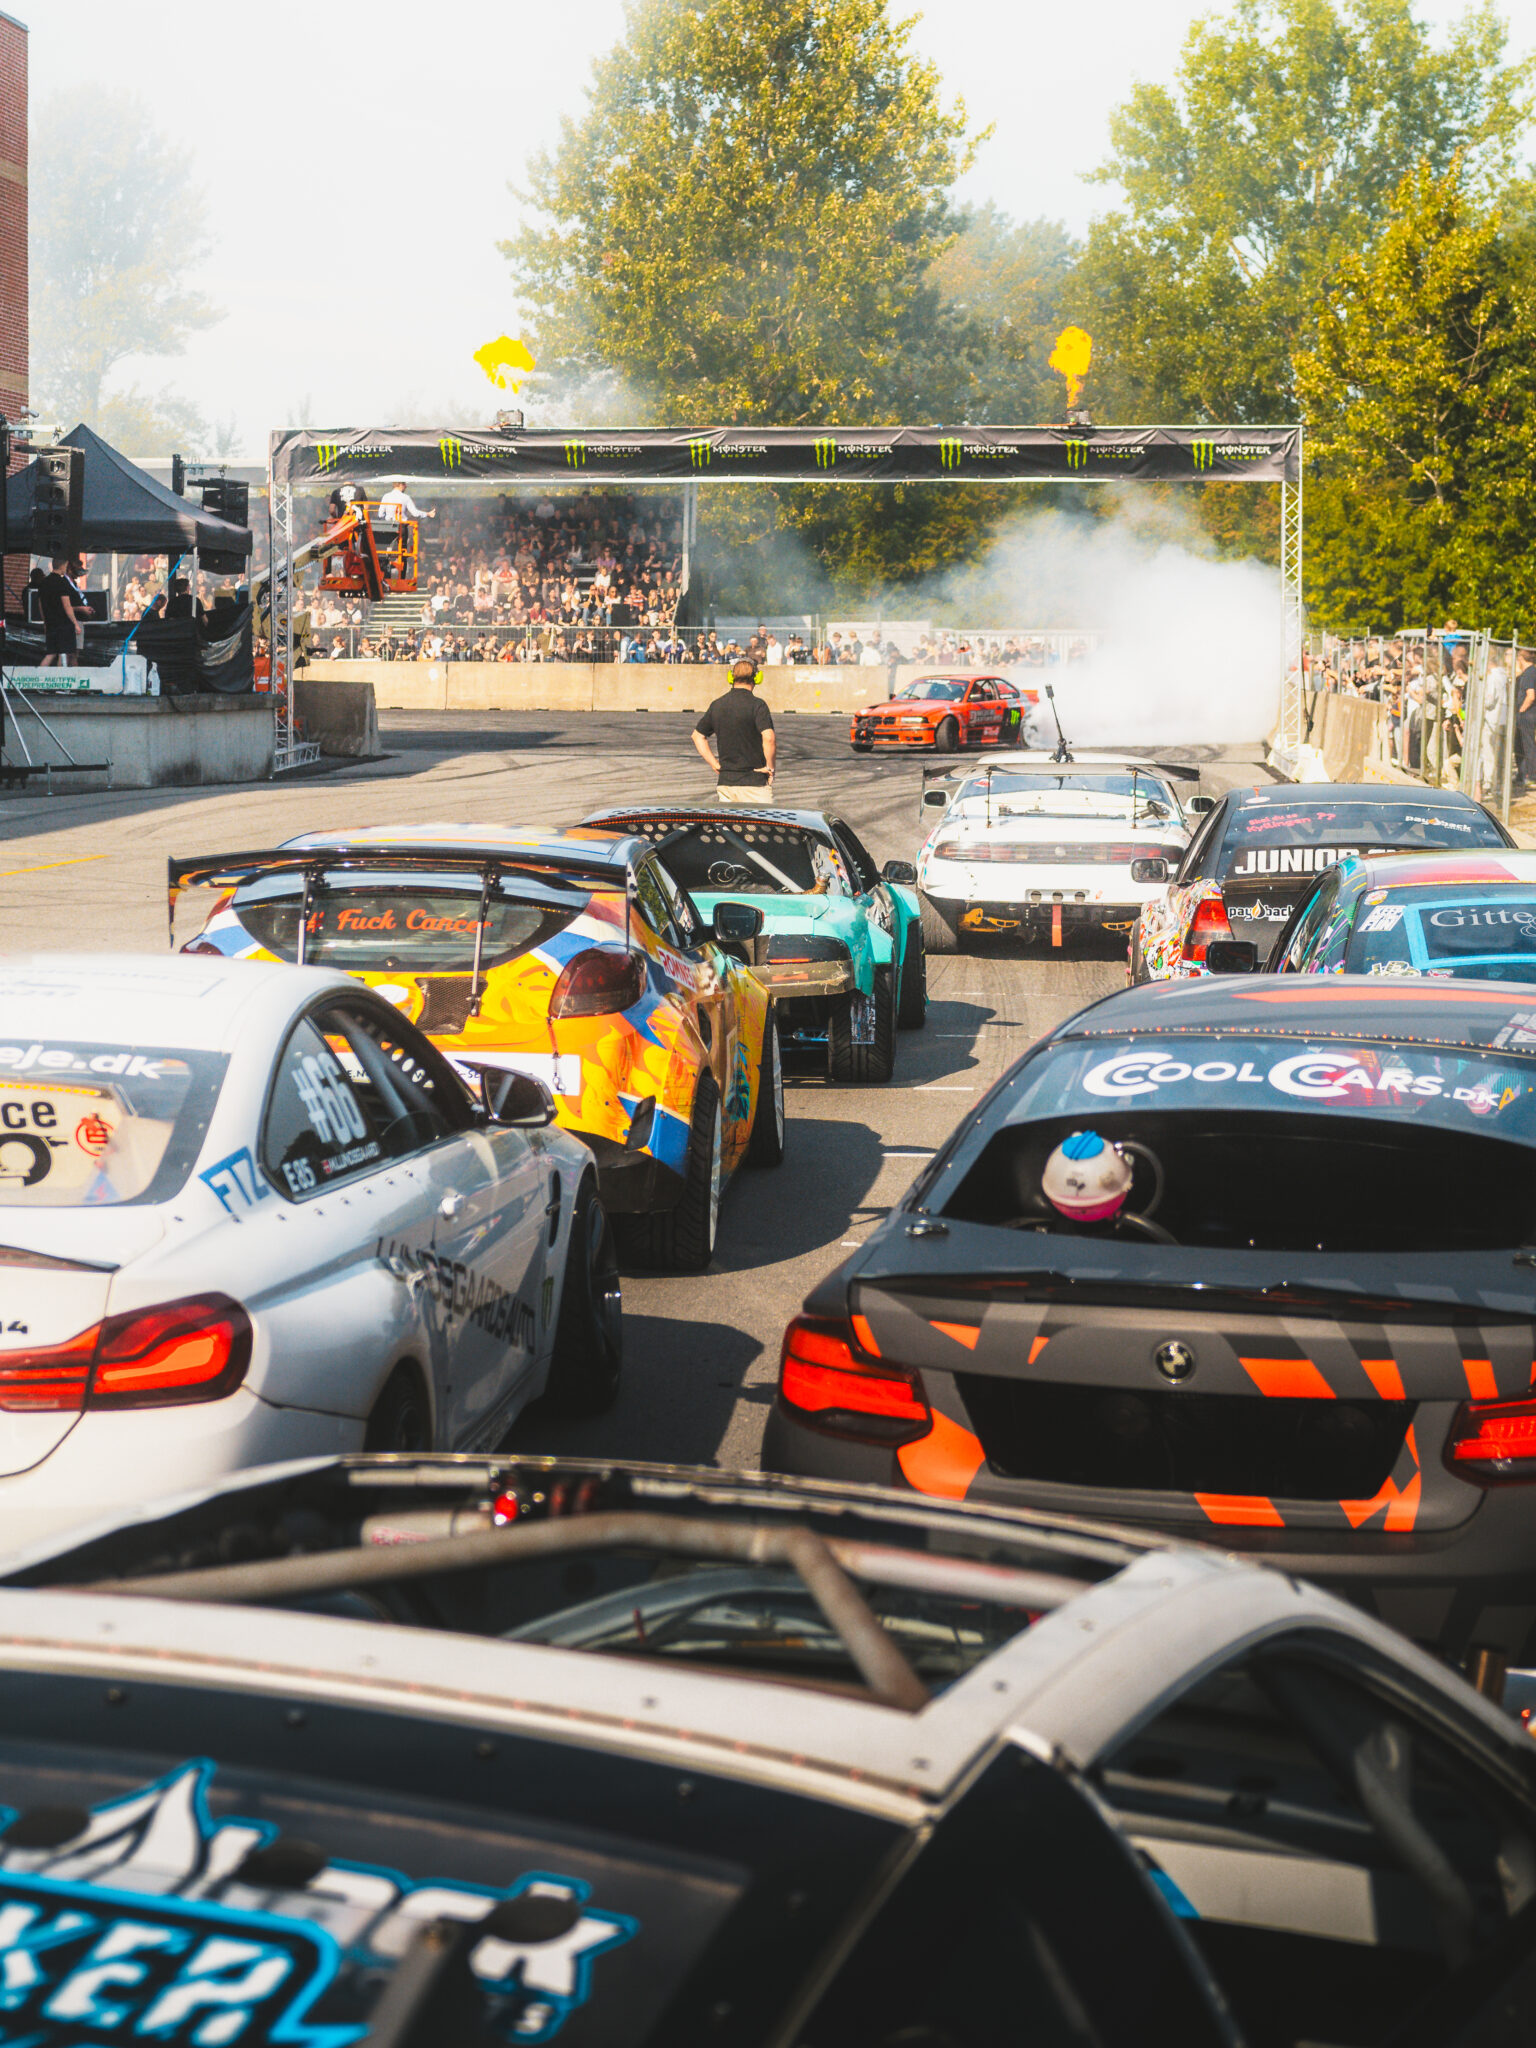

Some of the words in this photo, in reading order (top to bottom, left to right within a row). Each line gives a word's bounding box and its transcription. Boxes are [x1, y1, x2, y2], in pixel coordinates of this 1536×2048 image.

[340, 445, 393, 454] MONSTER
[463, 444, 517, 454] MONSTER
[588, 445, 642, 454] MONSTER
[713, 444, 767, 454] MONSTER
[838, 444, 893, 454] MONSTER
[963, 445, 1019, 455] MONSTER
[1089, 445, 1145, 454] MONSTER
[1215, 445, 1271, 455] MONSTER
[337, 907, 397, 931] Fuck
[1430, 908, 1533, 927] Gitte
[291, 1052, 367, 1145] #66
